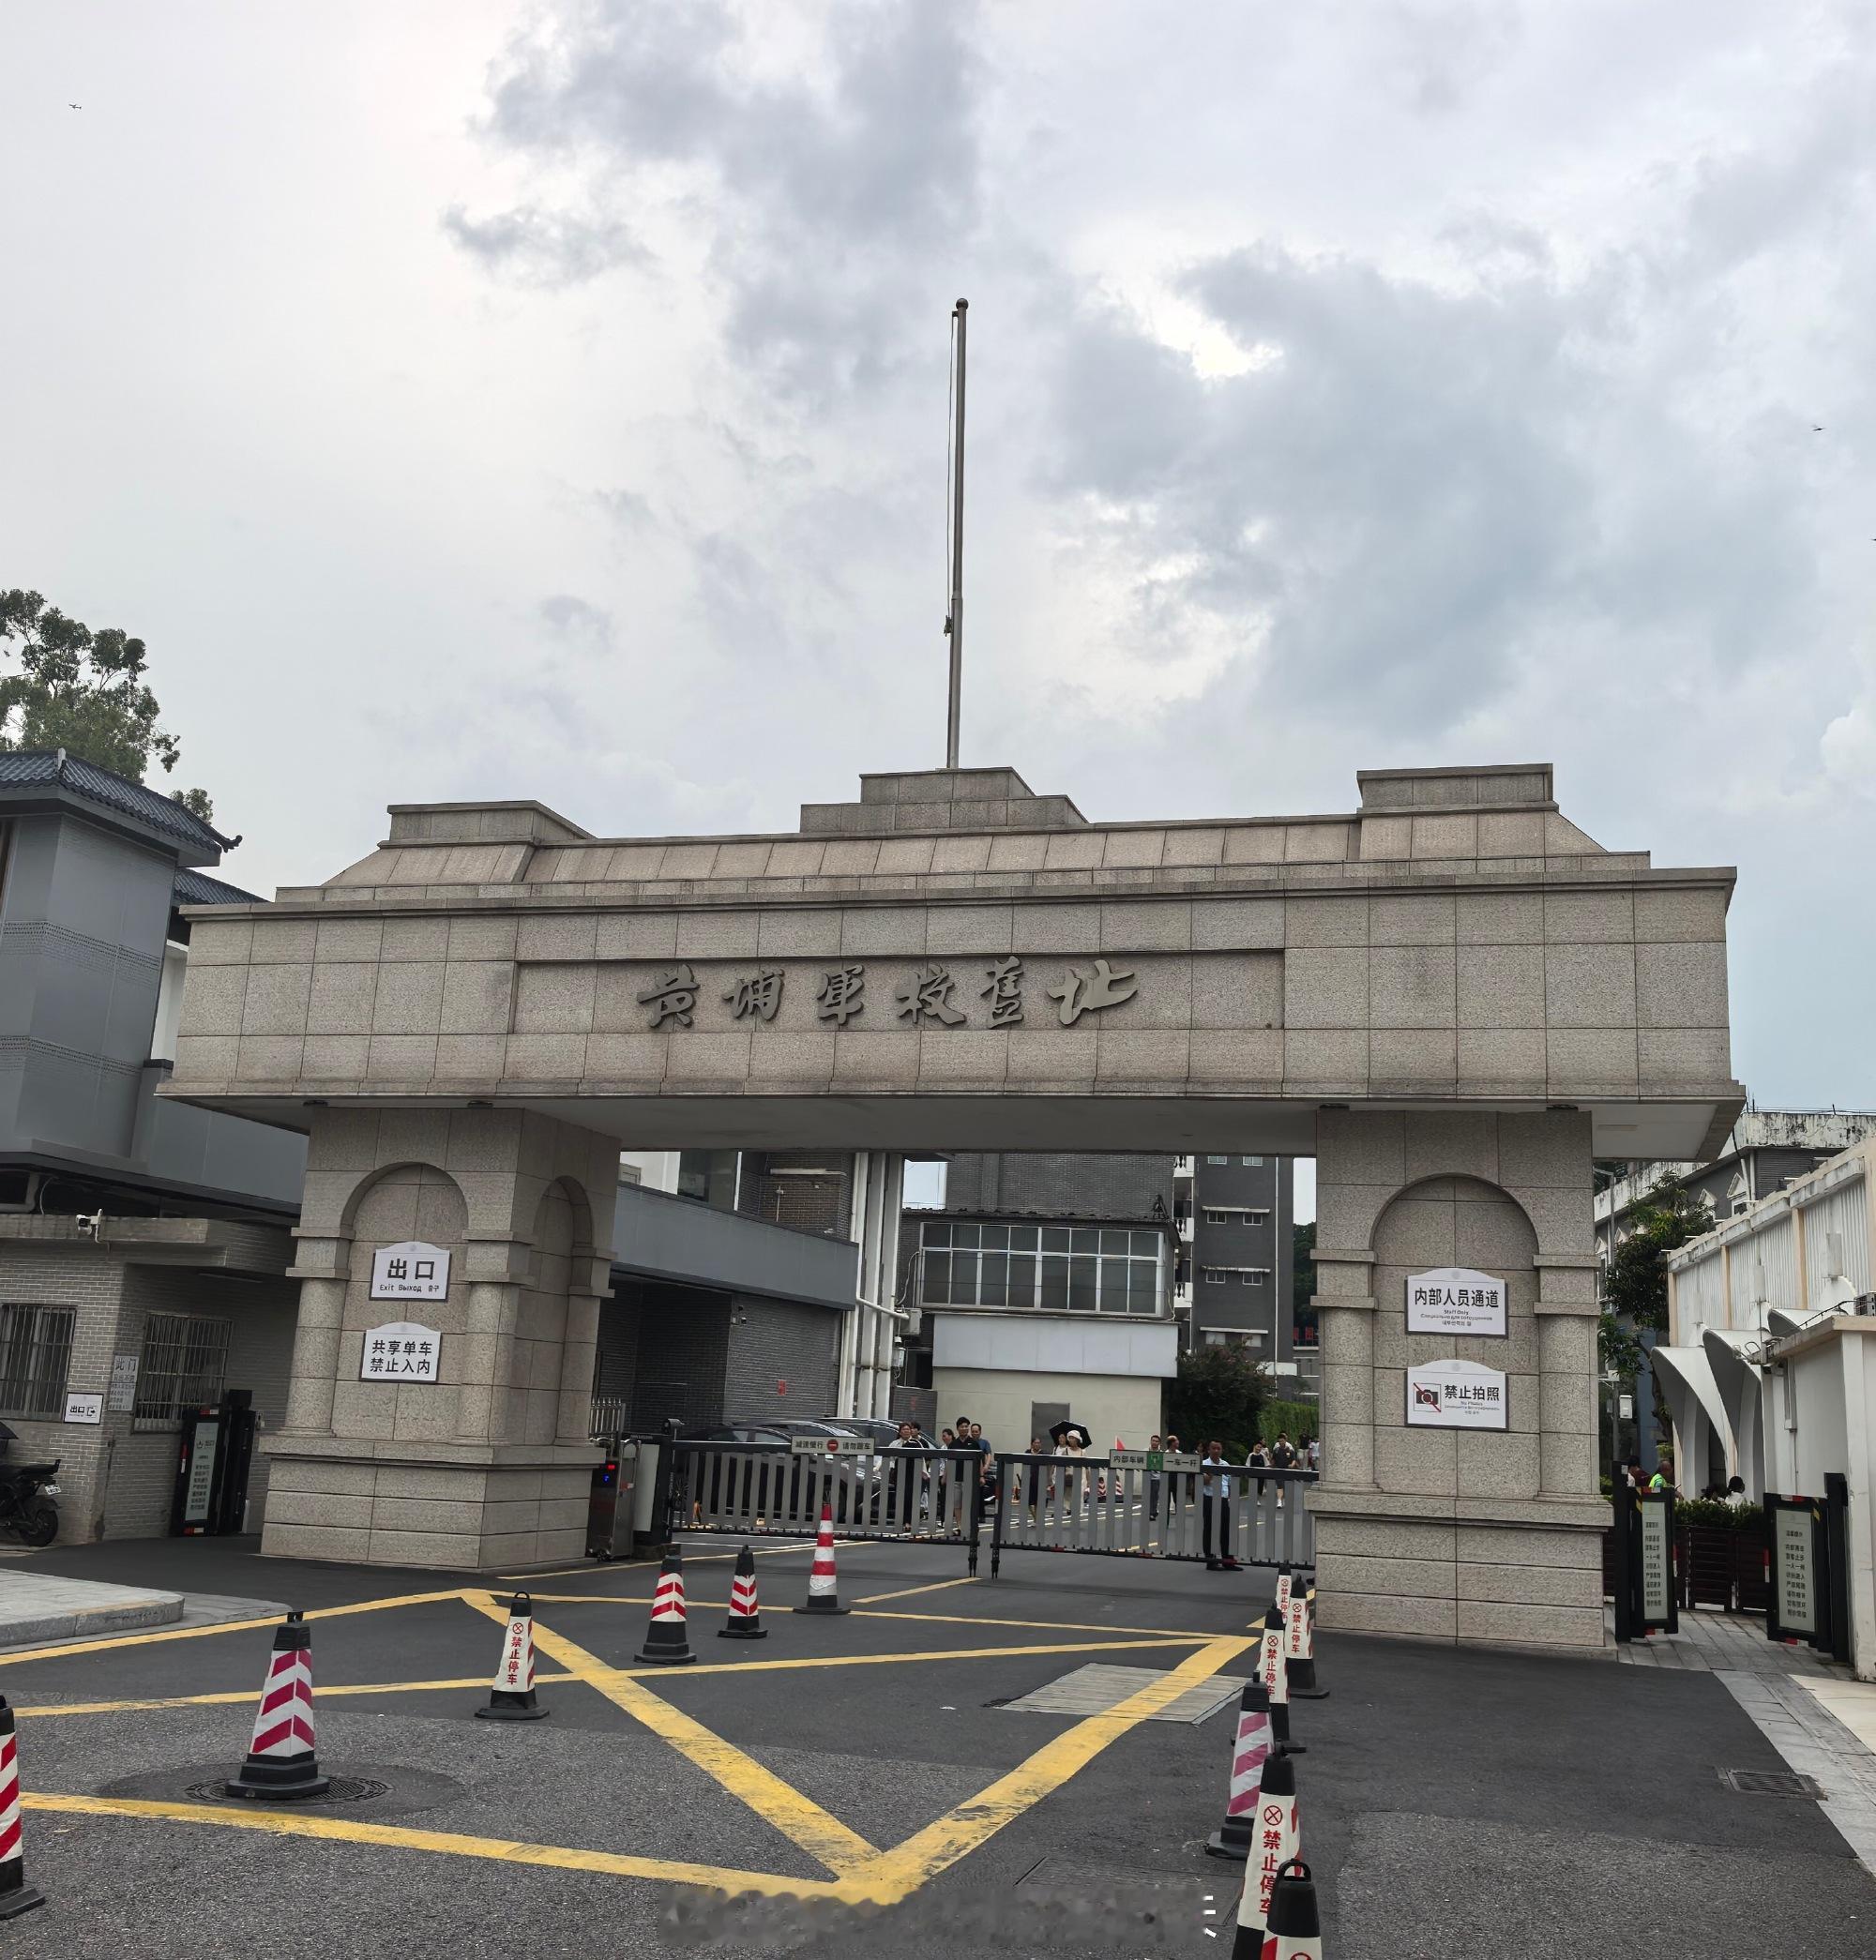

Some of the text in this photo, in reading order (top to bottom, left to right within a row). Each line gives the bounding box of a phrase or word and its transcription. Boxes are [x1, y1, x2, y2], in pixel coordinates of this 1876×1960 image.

[387, 1259, 434, 1280] 出口
[1415, 1288, 1499, 1308] 内部人员通道
[371, 1339, 432, 1356] 共享单车
[370, 1359, 431, 1374] 禁止入内
[1445, 1384, 1500, 1401] 禁止拍照
[1279, 1588, 1289, 1619] 禁止停车
[1291, 1614, 1302, 1652] 禁止停车
[507, 1636, 522, 1685] 禁止停车
[1265, 1649, 1278, 1696] 禁止停车
